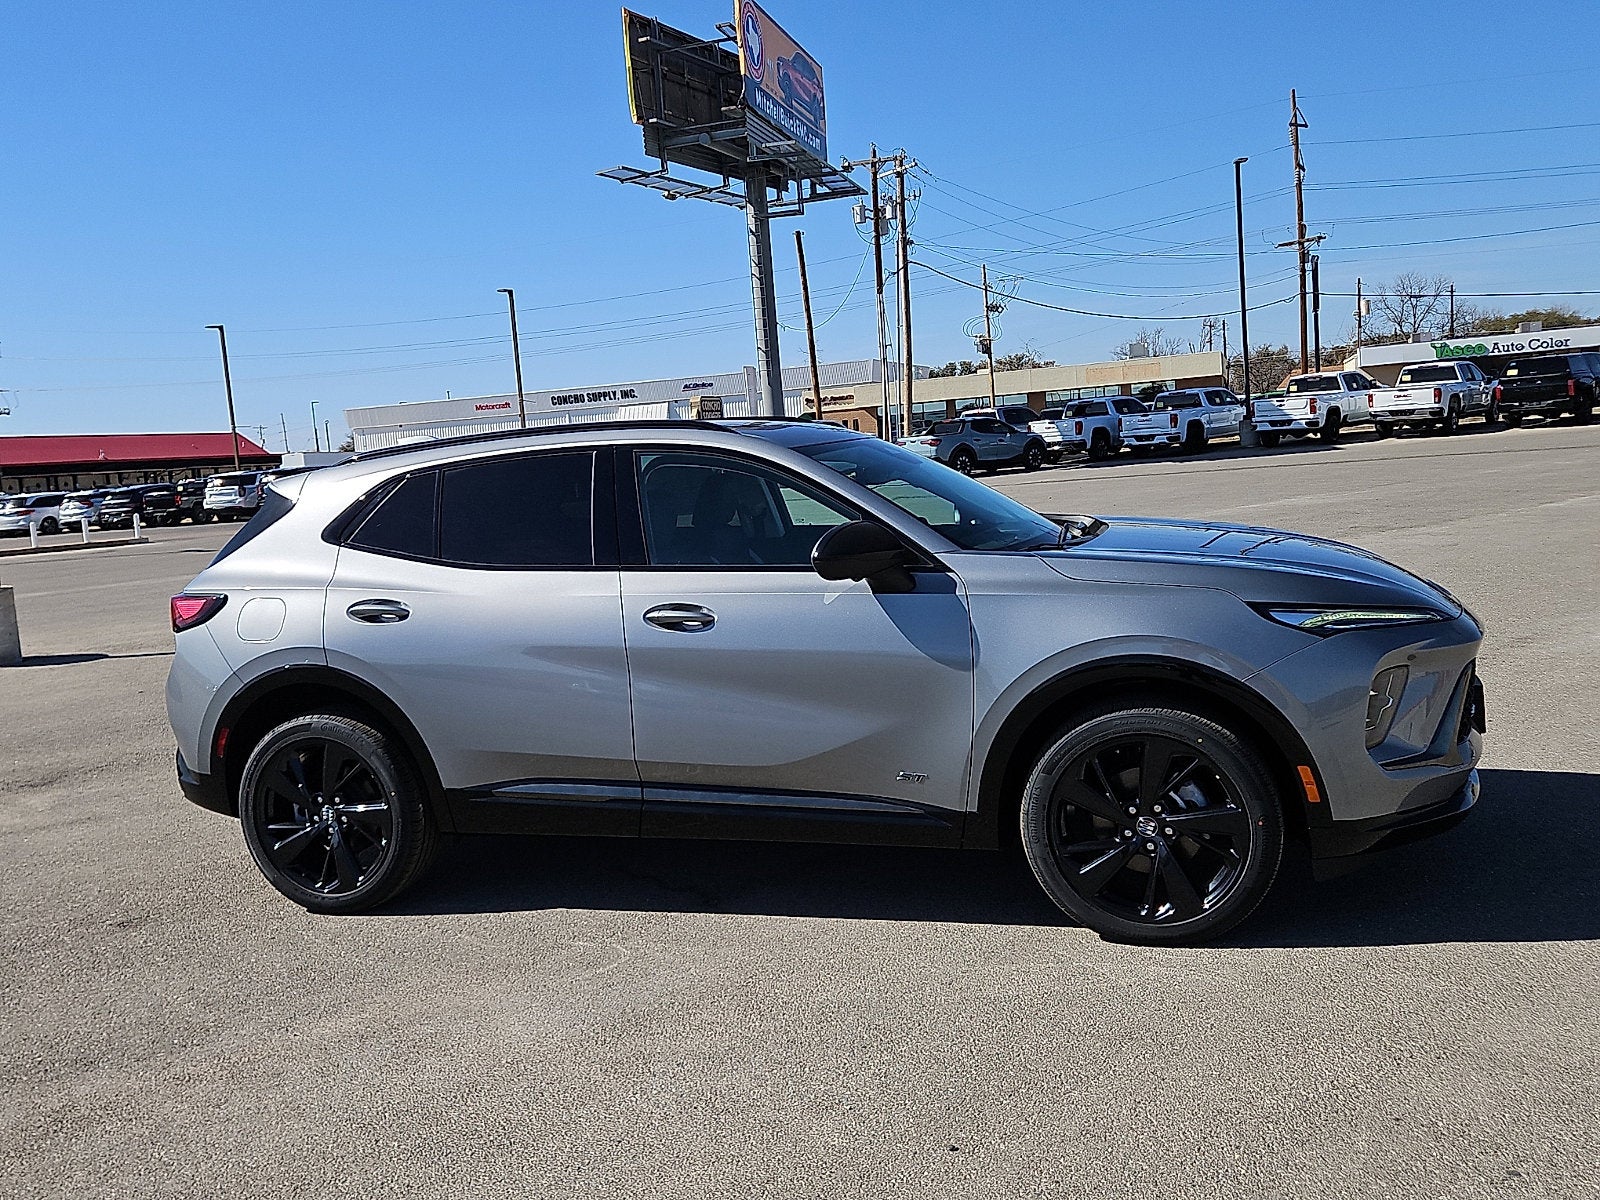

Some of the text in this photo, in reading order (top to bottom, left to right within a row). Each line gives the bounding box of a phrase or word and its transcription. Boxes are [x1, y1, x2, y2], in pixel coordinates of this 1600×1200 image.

[1430, 338, 1571, 358] TASCO Auto Color
[474, 401, 512, 411] Motorcraft
[551, 388, 638, 406] CONCHO SUPPLY, INC.
